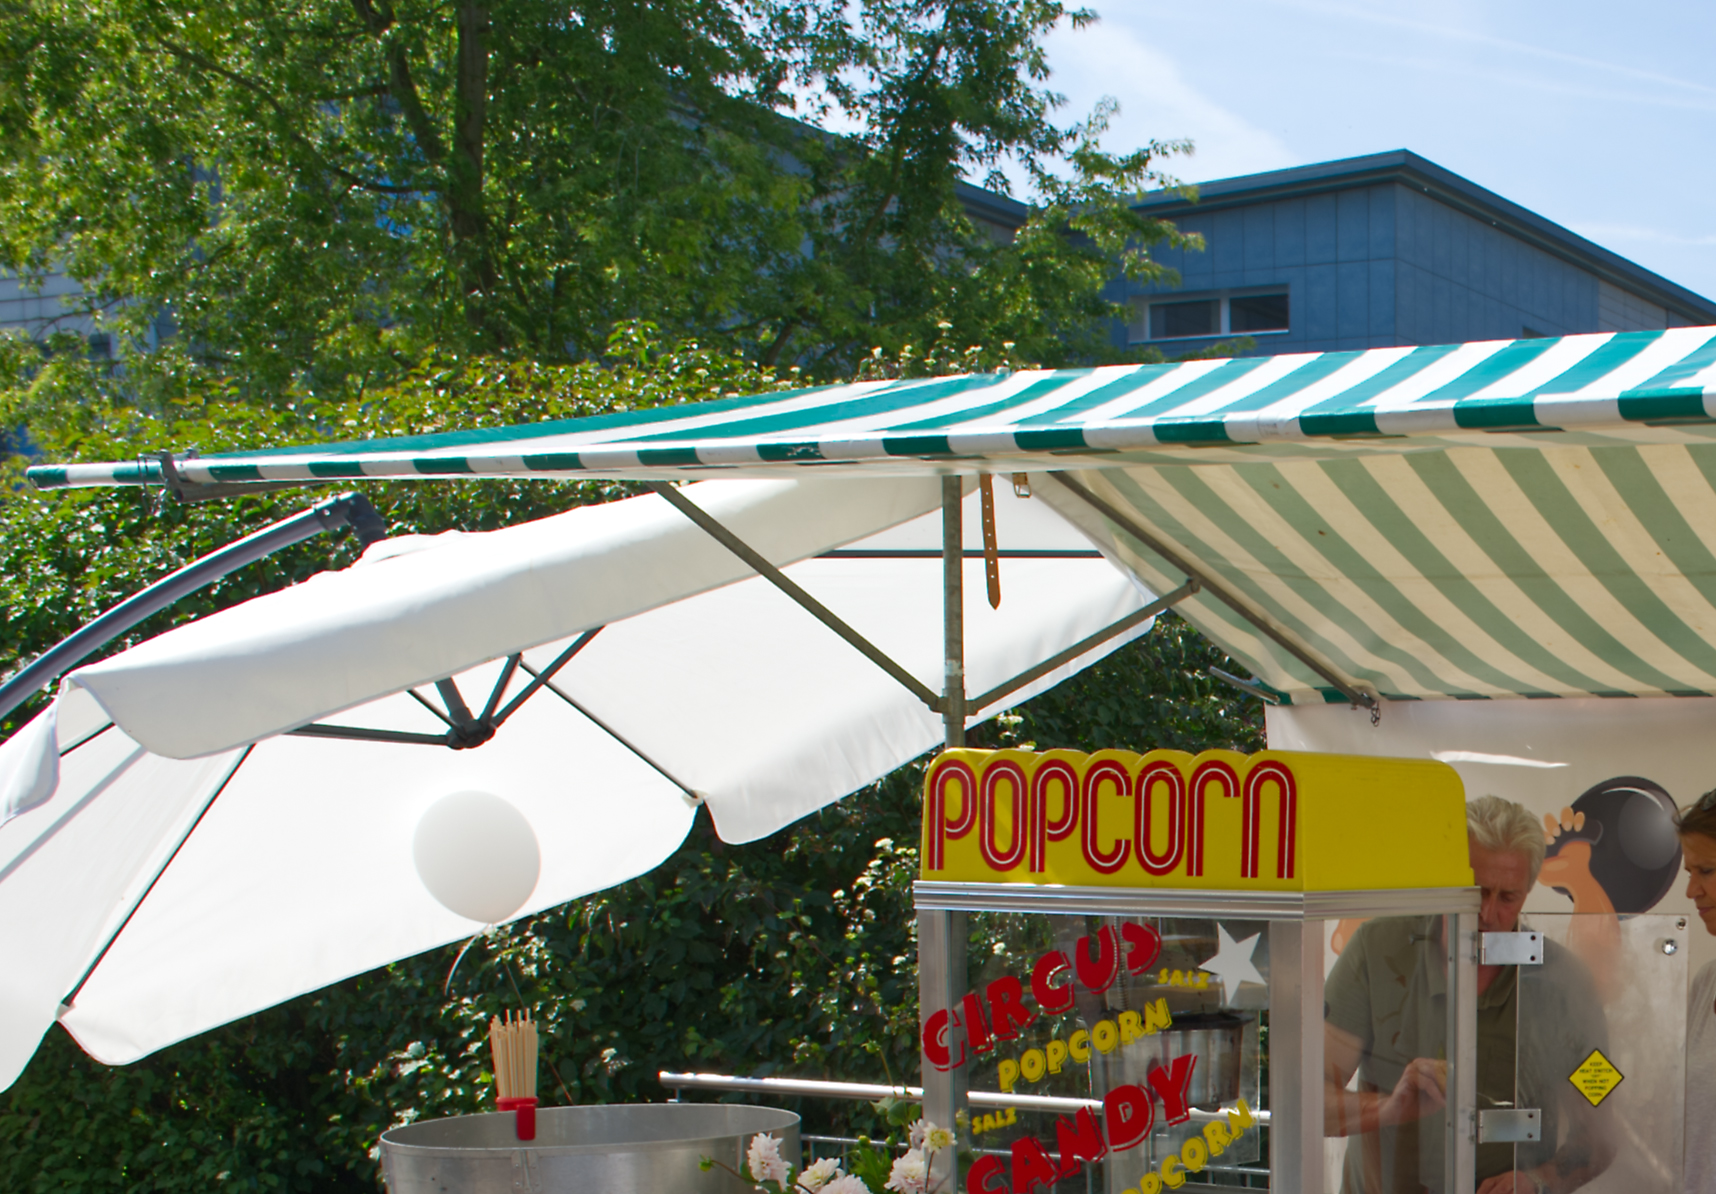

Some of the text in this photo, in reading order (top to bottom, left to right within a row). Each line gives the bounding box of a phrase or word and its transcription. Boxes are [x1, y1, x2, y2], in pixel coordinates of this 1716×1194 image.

[928, 759, 1297, 879] POPCORN
[923, 921, 1161, 1071] CIRCUS
[998, 997, 1173, 1093] POPCORN
[971, 1106, 1018, 1136] SALZ
